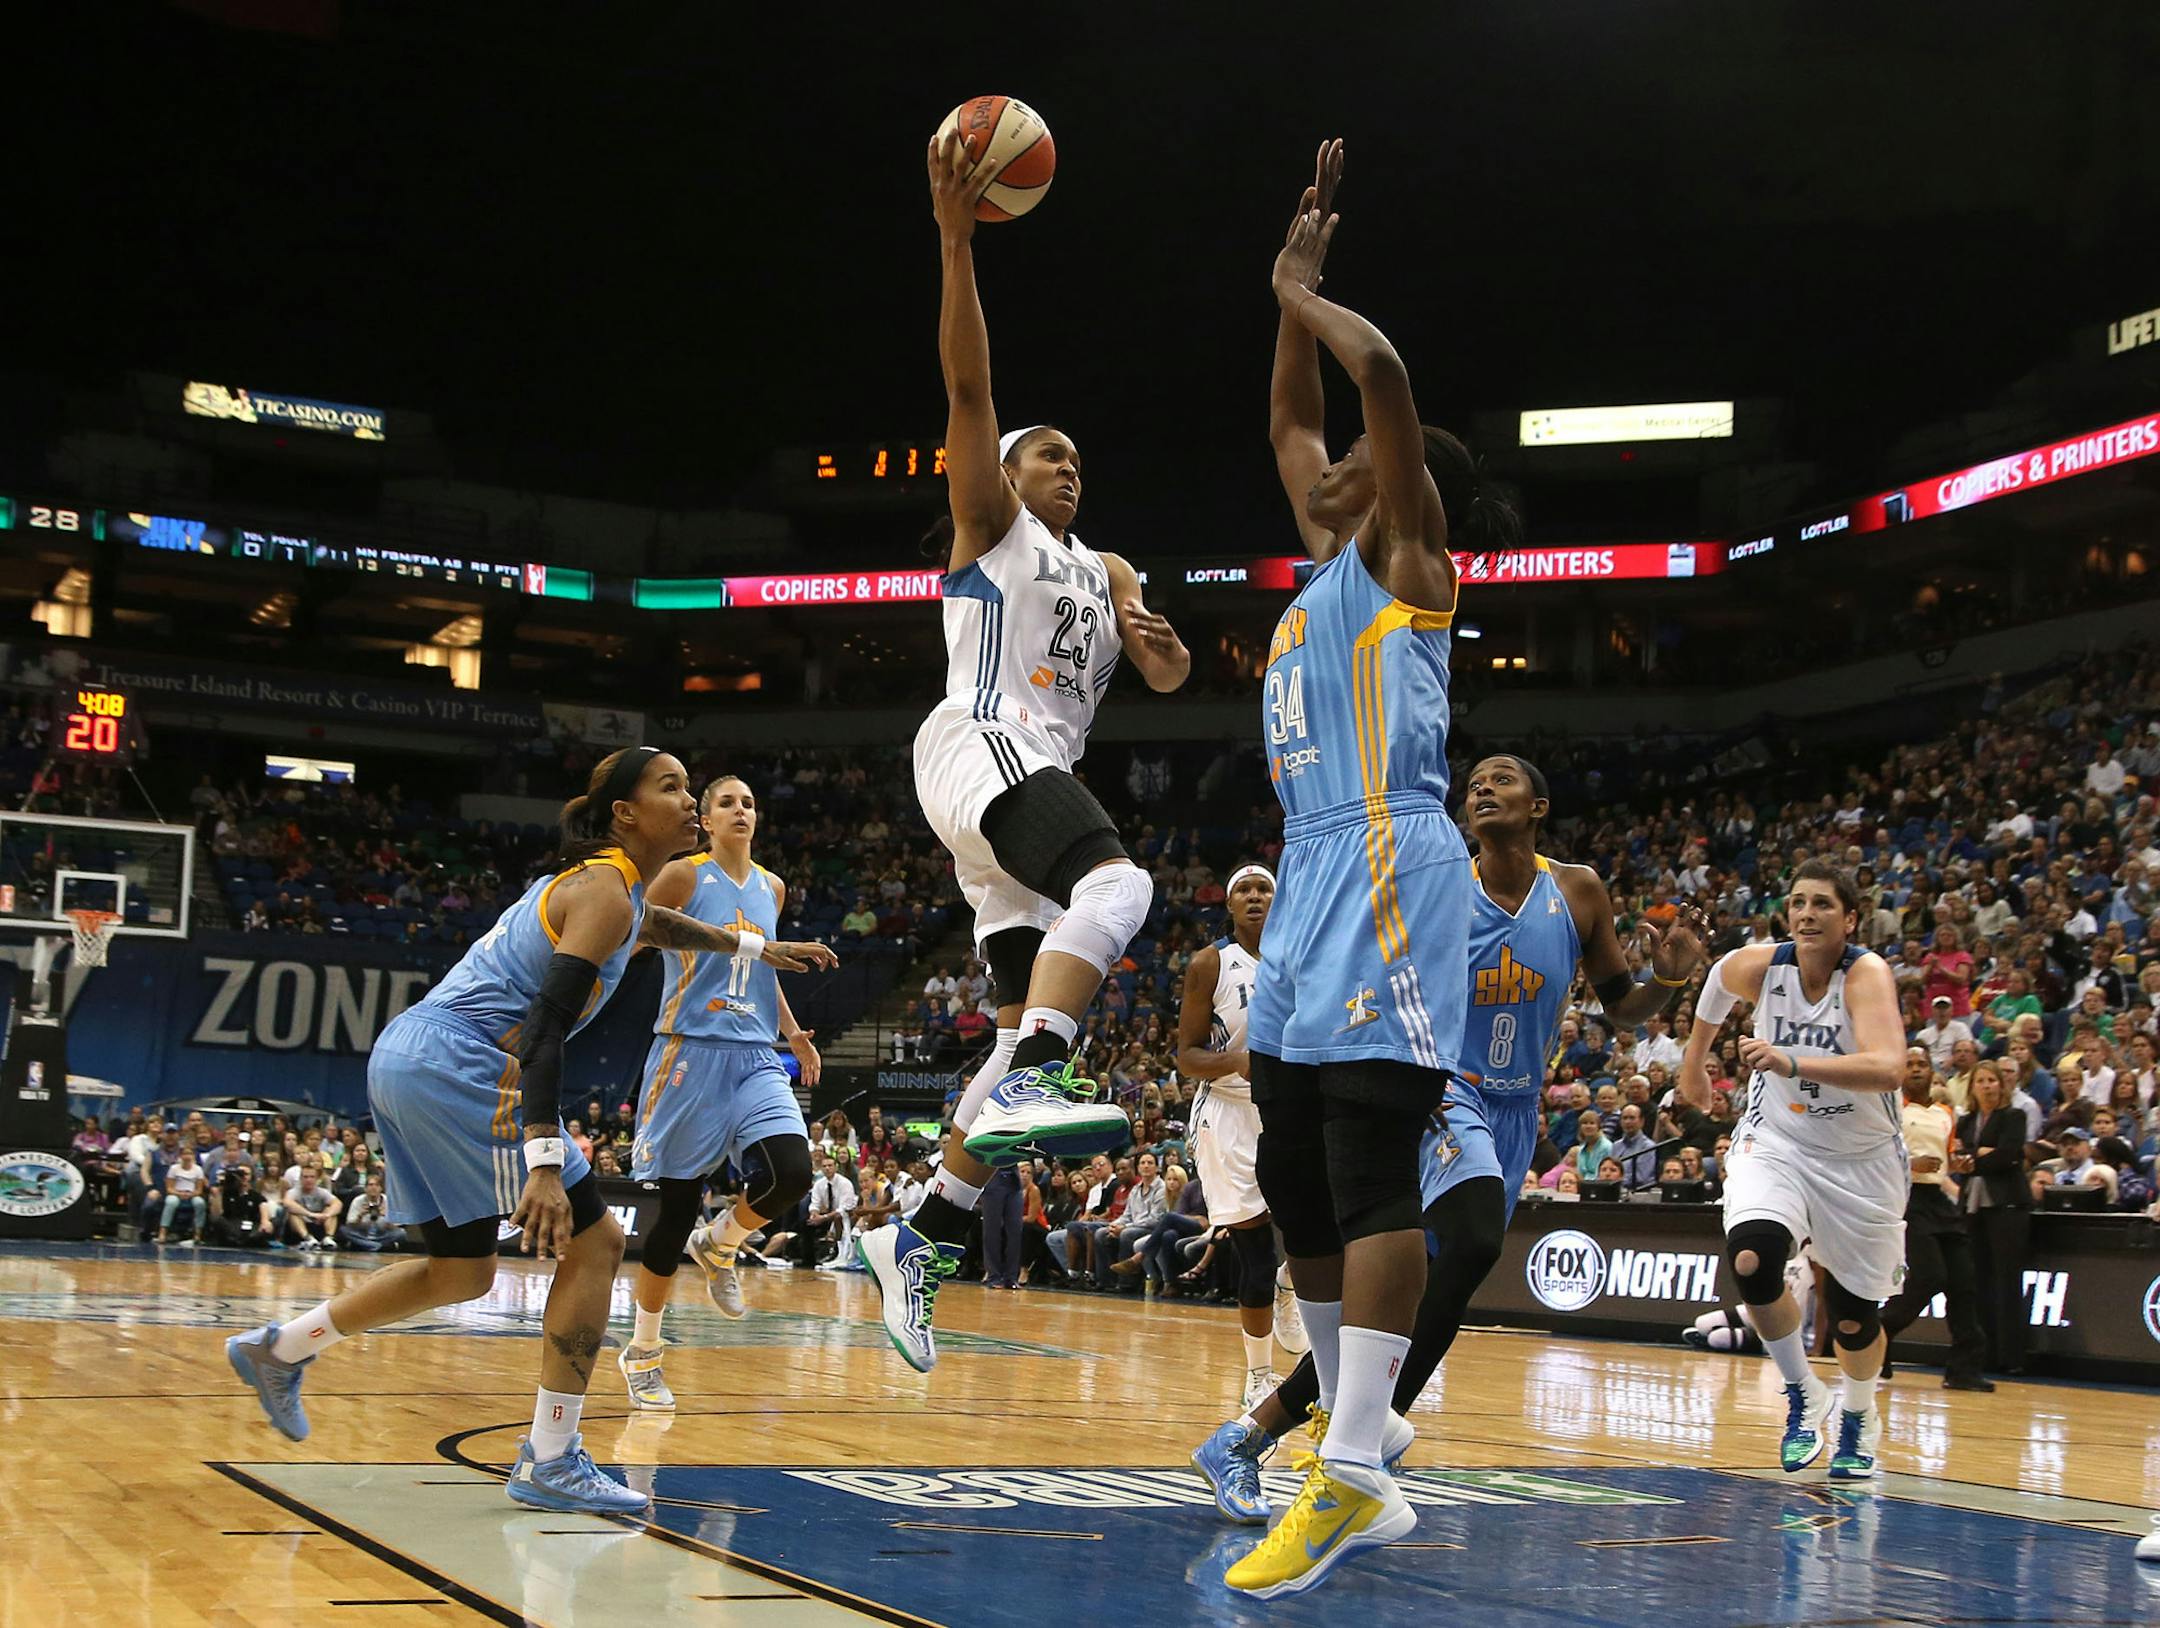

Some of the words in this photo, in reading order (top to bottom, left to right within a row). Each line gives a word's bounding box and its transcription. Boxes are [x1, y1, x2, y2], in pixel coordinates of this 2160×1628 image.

[254, 398, 382, 430] TICASINO.COM
[1937, 459, 2024, 506] COPIERS
[2028, 453, 2046, 482] &
[2051, 420, 2160, 476] PRINTERS
[29, 506, 80, 532] 28
[1495, 550, 1615, 578] PRINTERS
[761, 580, 848, 601] COPIERS
[855, 577, 871, 599] &
[877, 574, 943, 598] PRINT
[1048, 596, 1098, 670] 23
[77, 691, 127, 717] 4:08
[97, 665, 184, 692] Treasure
[190, 674, 252, 699] Island
[257, 681, 322, 706] Resort
[327, 688, 347, 708] &
[351, 691, 420, 716] Casino
[424, 699, 465, 721] VIP
[467, 703, 540, 729] Terrace
[1269, 664, 1308, 746] 34
[67, 714, 118, 752] 20
[728, 955, 752, 997] 11
[1488, 1012, 1517, 1069] 8
[1482, 1073, 1532, 1091] boost
[0, 1154, 68, 1169] INNESOTA
[1545, 1246, 1588, 1280] FOX
[1543, 1279, 1589, 1294] SPORTS
